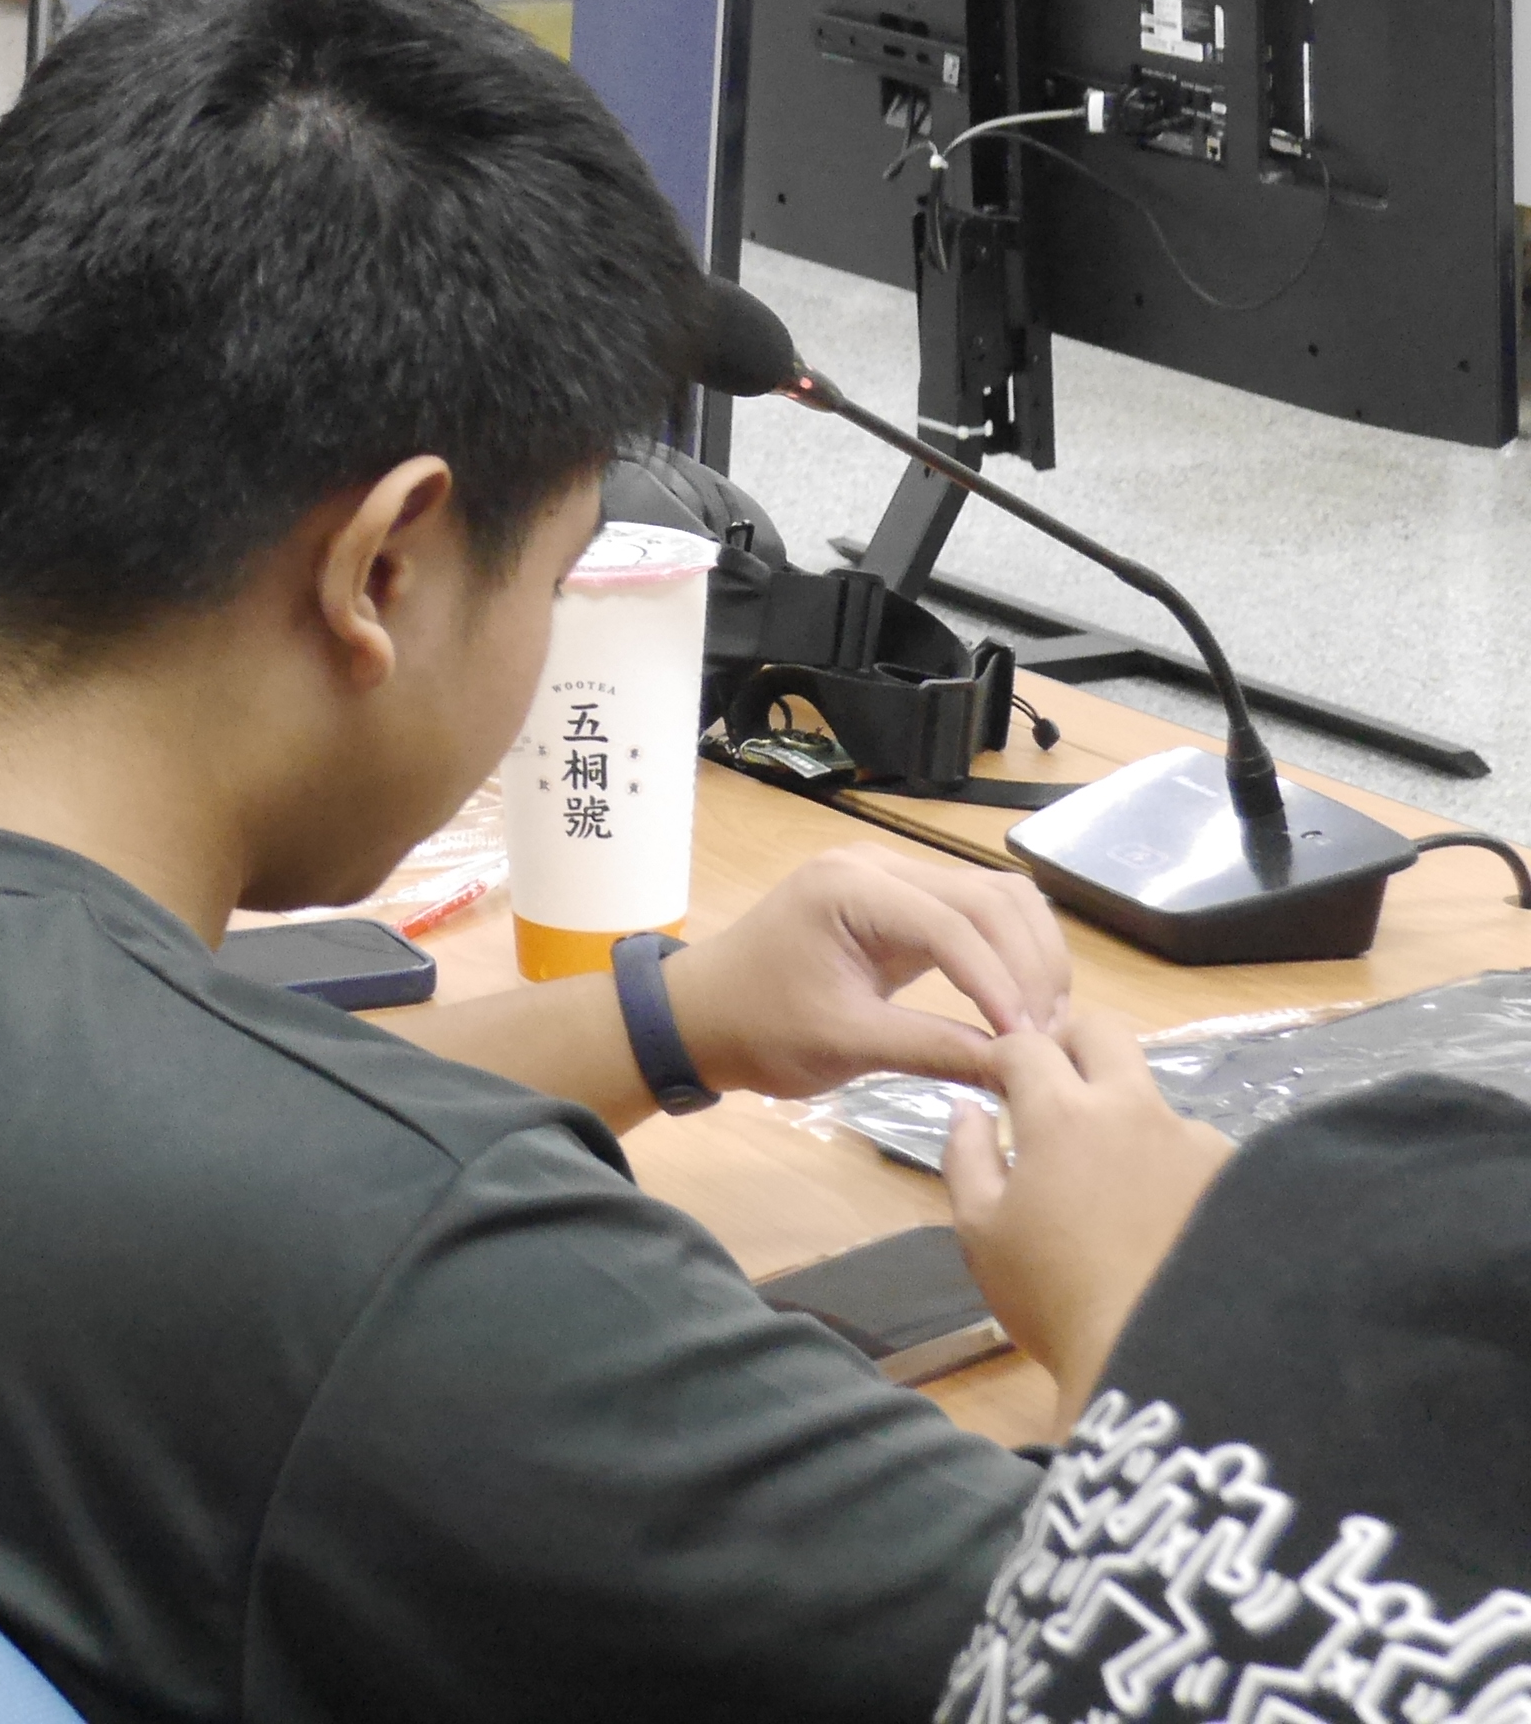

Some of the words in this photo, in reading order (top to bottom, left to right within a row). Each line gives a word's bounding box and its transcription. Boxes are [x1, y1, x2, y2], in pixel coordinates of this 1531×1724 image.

[552, 680, 616, 696] WOOTEA
[561, 703, 613, 840] 五桐號
